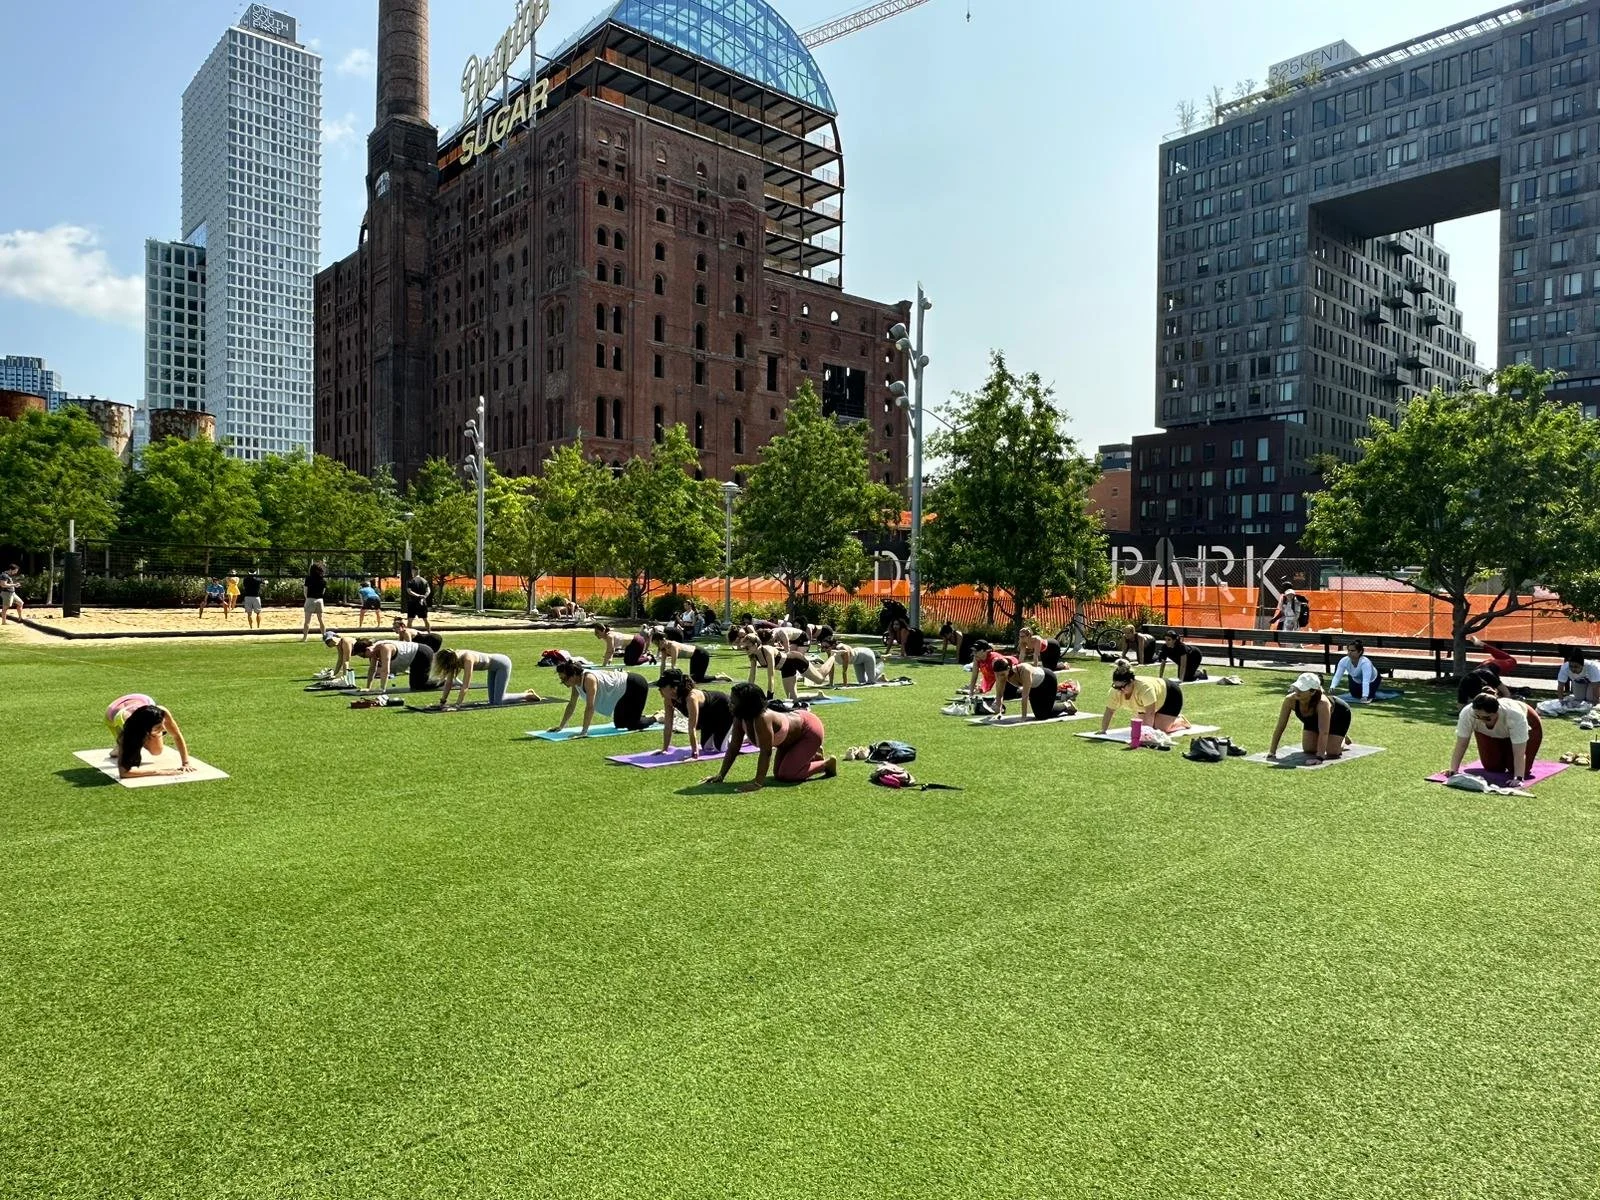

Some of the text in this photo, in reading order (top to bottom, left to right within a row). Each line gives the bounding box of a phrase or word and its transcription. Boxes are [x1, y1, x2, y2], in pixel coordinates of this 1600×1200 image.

[252, 5, 274, 18] ONE
[252, 12, 289, 31] SOUTH
[459, 78, 549, 165] SUGAR
[1111, 544, 1286, 603] PARK
